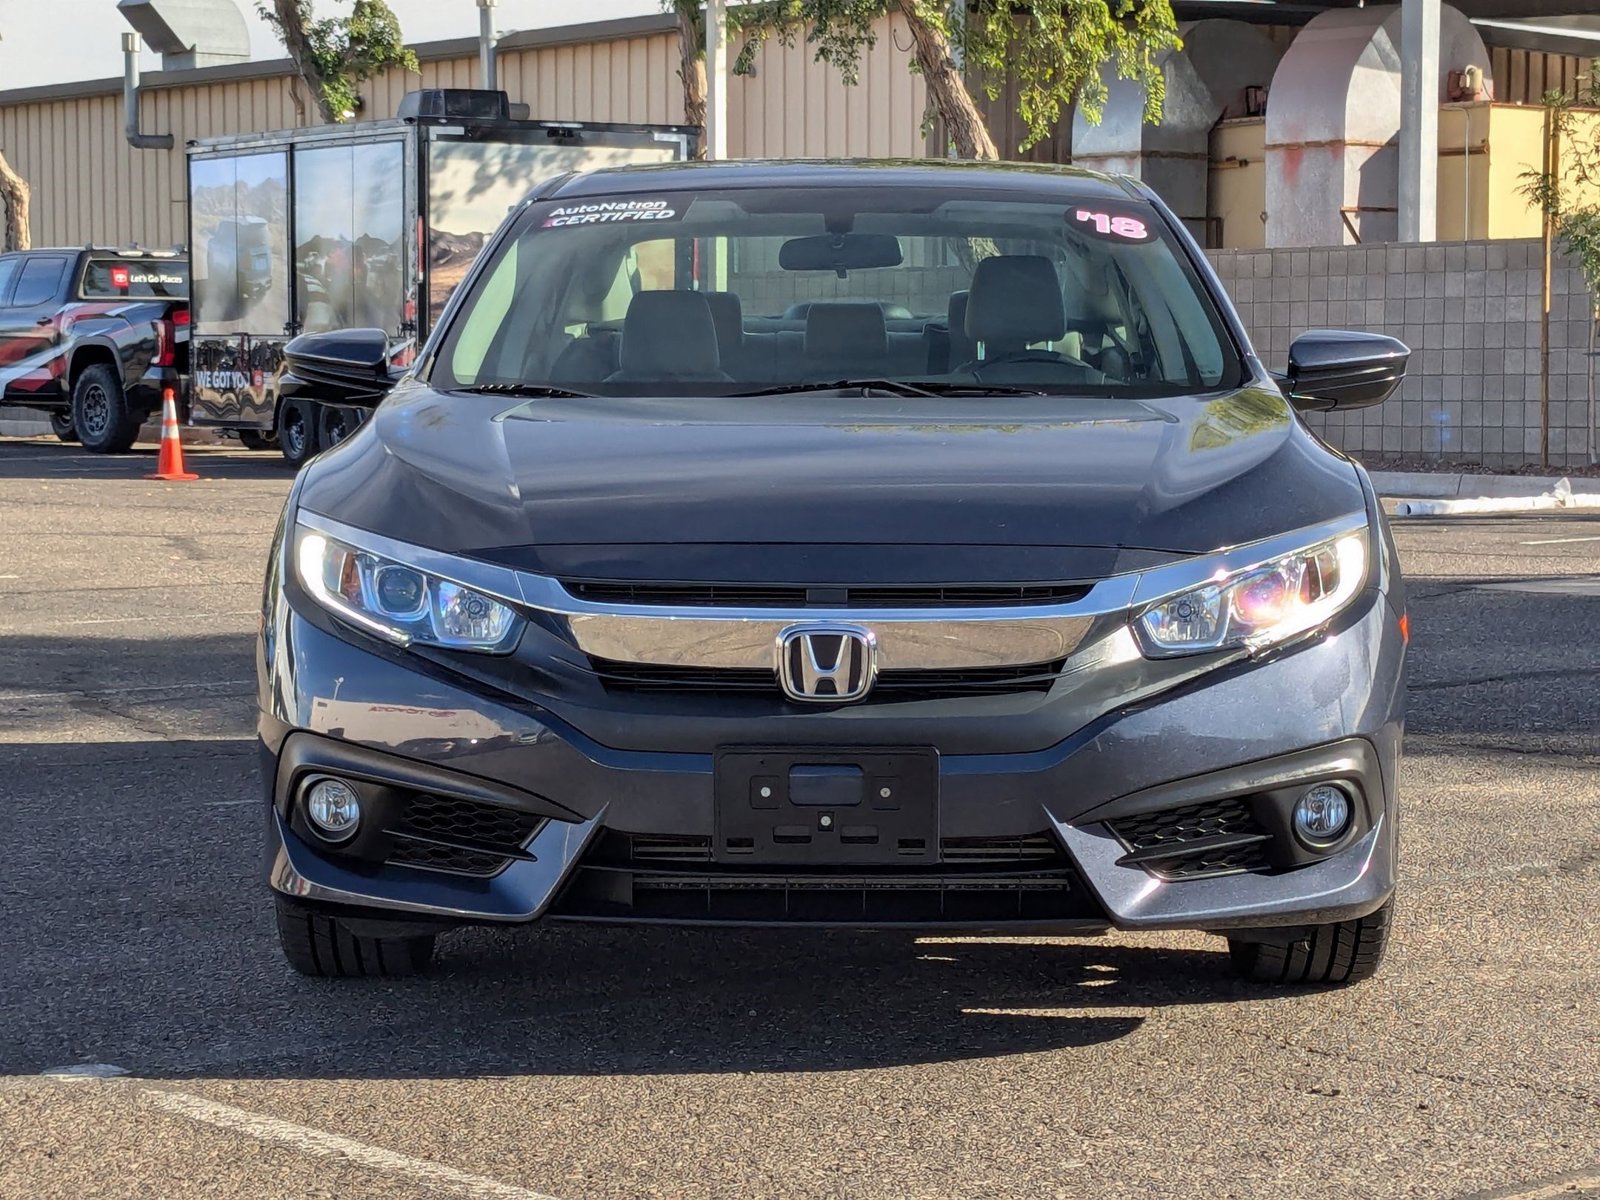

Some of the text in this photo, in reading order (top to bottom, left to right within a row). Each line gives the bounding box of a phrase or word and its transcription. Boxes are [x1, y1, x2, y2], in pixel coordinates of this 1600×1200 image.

[549, 201, 667, 217] AutoNation
[551, 209, 675, 227] CERTIFIED
[1076, 210, 1148, 239] '18
[147, 274, 159, 283] Go
[160, 274, 183, 284] Places
[196, 371, 212, 388] WE
[212, 371, 231, 388] GOT
